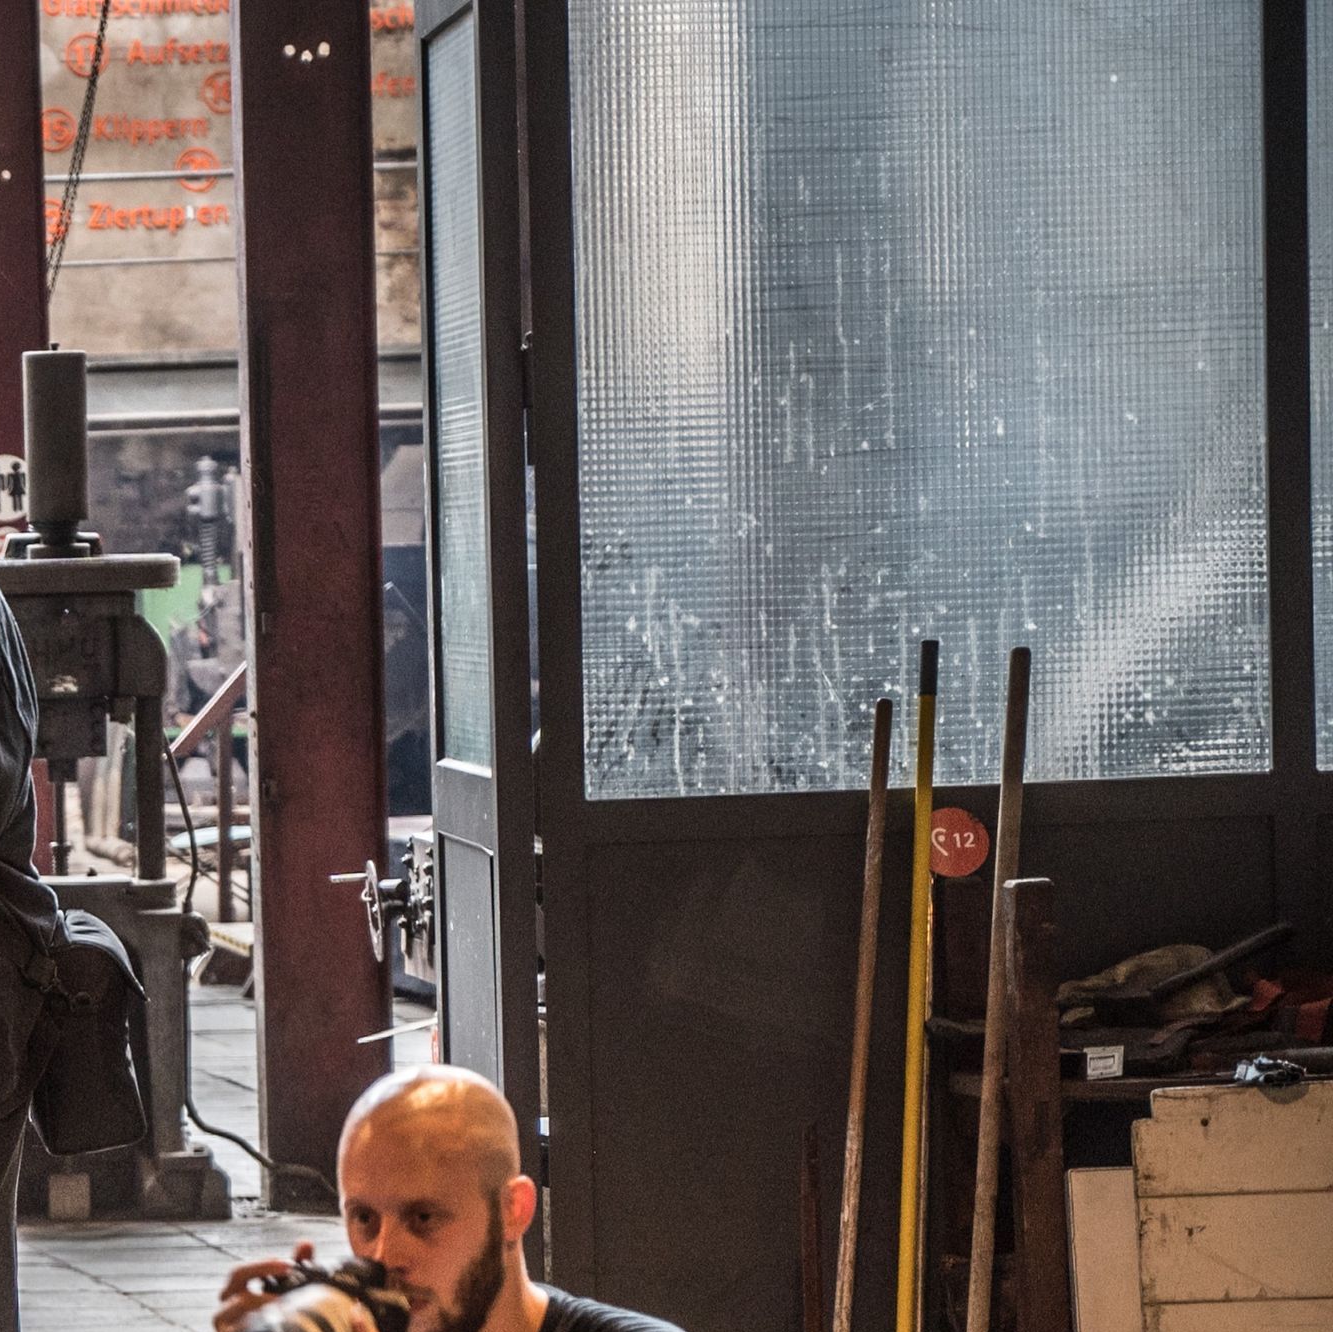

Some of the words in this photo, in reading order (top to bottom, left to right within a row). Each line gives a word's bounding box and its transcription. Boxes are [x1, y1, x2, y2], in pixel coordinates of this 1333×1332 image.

[128, 38, 229, 65] Aufsetz
[94, 112, 208, 146] Klippern
[89, 202, 229, 235] Ziertupen
[953, 832, 976, 848] 12
